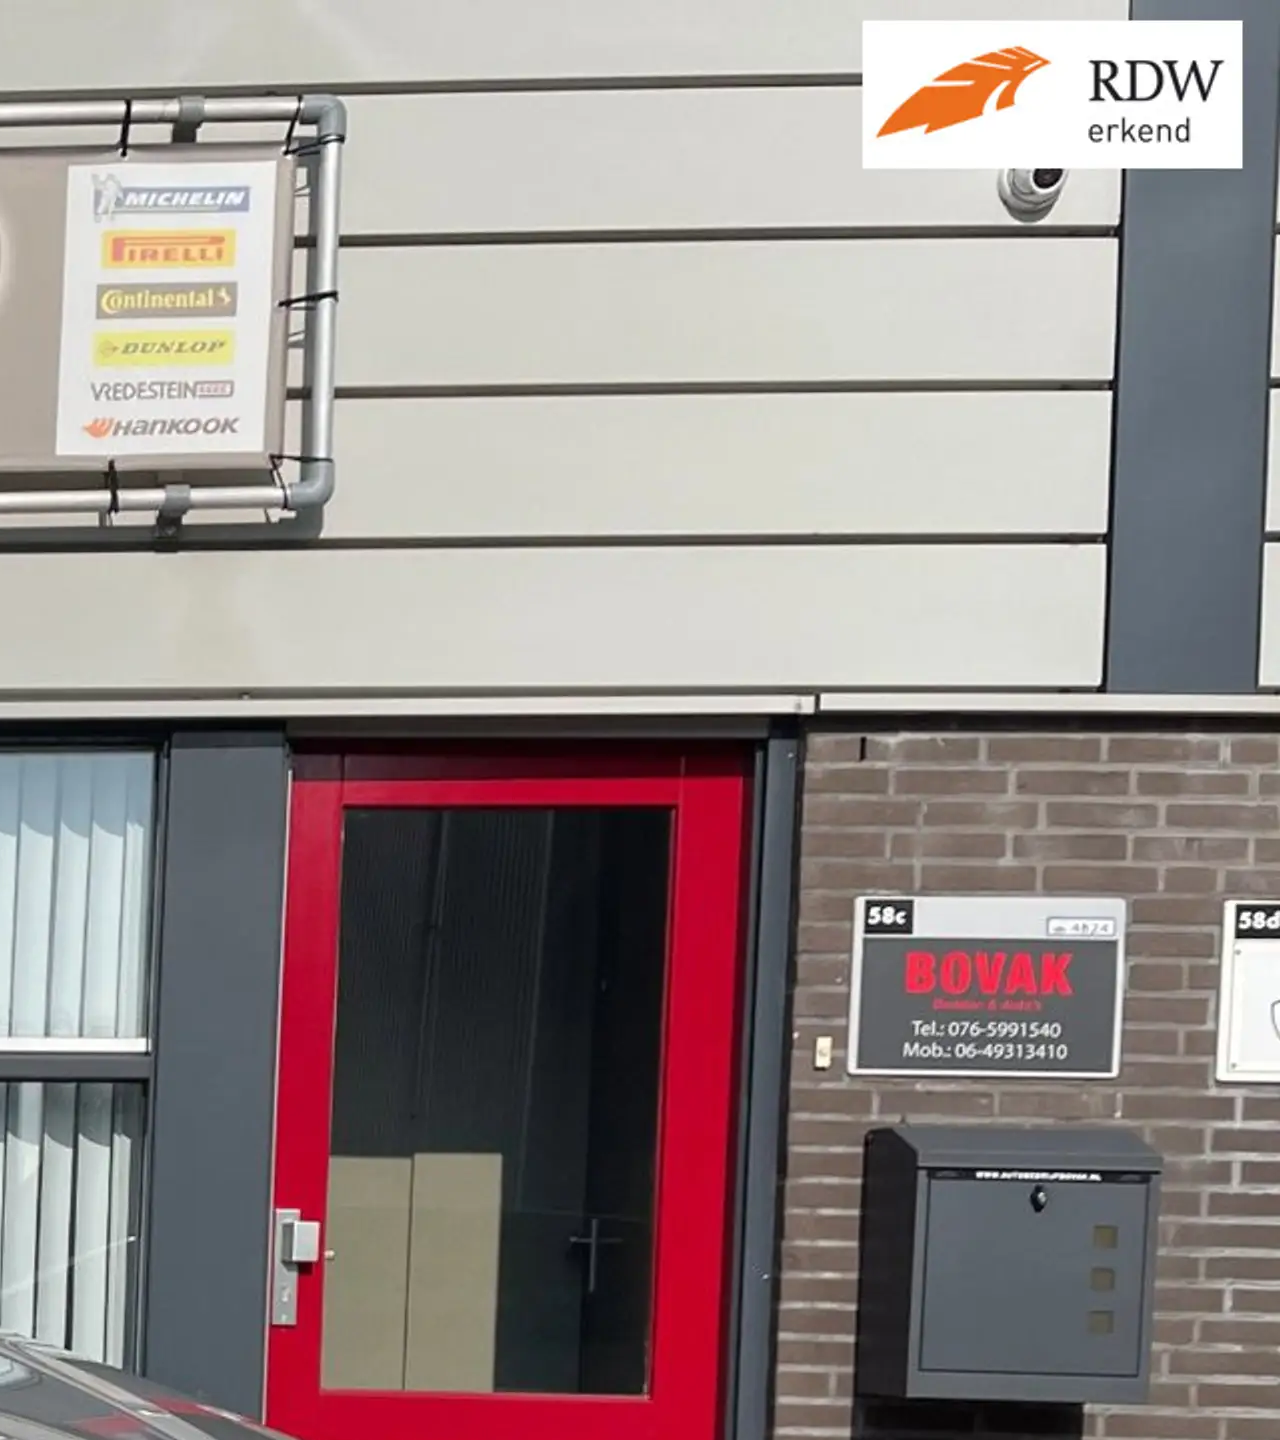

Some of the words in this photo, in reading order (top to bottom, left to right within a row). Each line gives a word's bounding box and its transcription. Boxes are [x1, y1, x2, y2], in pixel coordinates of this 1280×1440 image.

[124, 190, 246, 206] MICHELIN
[112, 236, 225, 262] PIRELLI
[101, 287, 214, 314] Continental
[121, 339, 227, 354] DUNLOP
[90, 381, 196, 401] VREDESTEIN
[868, 907, 907, 925] 58c
[905, 952, 1074, 995] BOVAK
[911, 1020, 945, 1036] Tel.:
[948, 1021, 1062, 1038] 076-5991540
[903, 1042, 951, 1058] Mob.:
[955, 1042, 1068, 1059] 06-49313410
